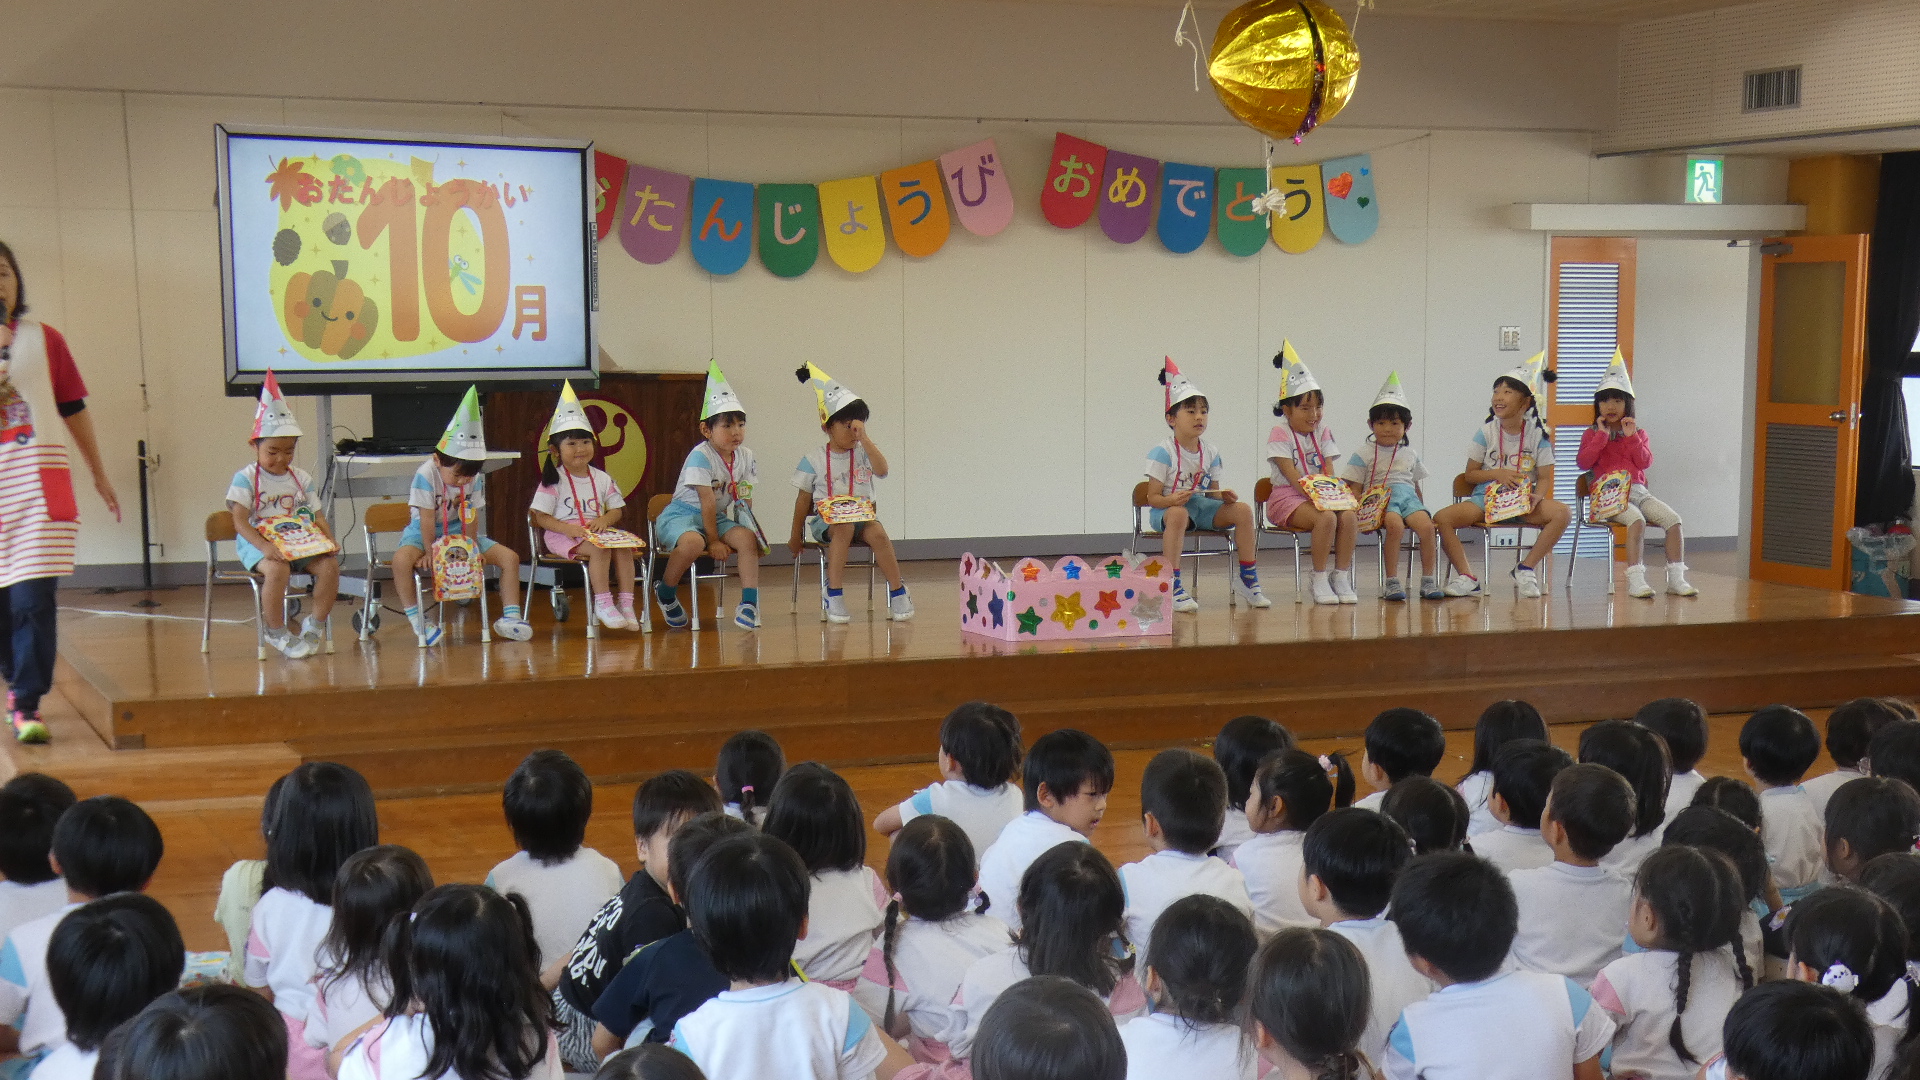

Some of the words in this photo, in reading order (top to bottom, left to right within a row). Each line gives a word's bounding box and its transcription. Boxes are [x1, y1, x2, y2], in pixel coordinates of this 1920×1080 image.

[298, 174, 529, 209] おたんじょうかい
[1052, 154, 1312, 222] おめでとう
